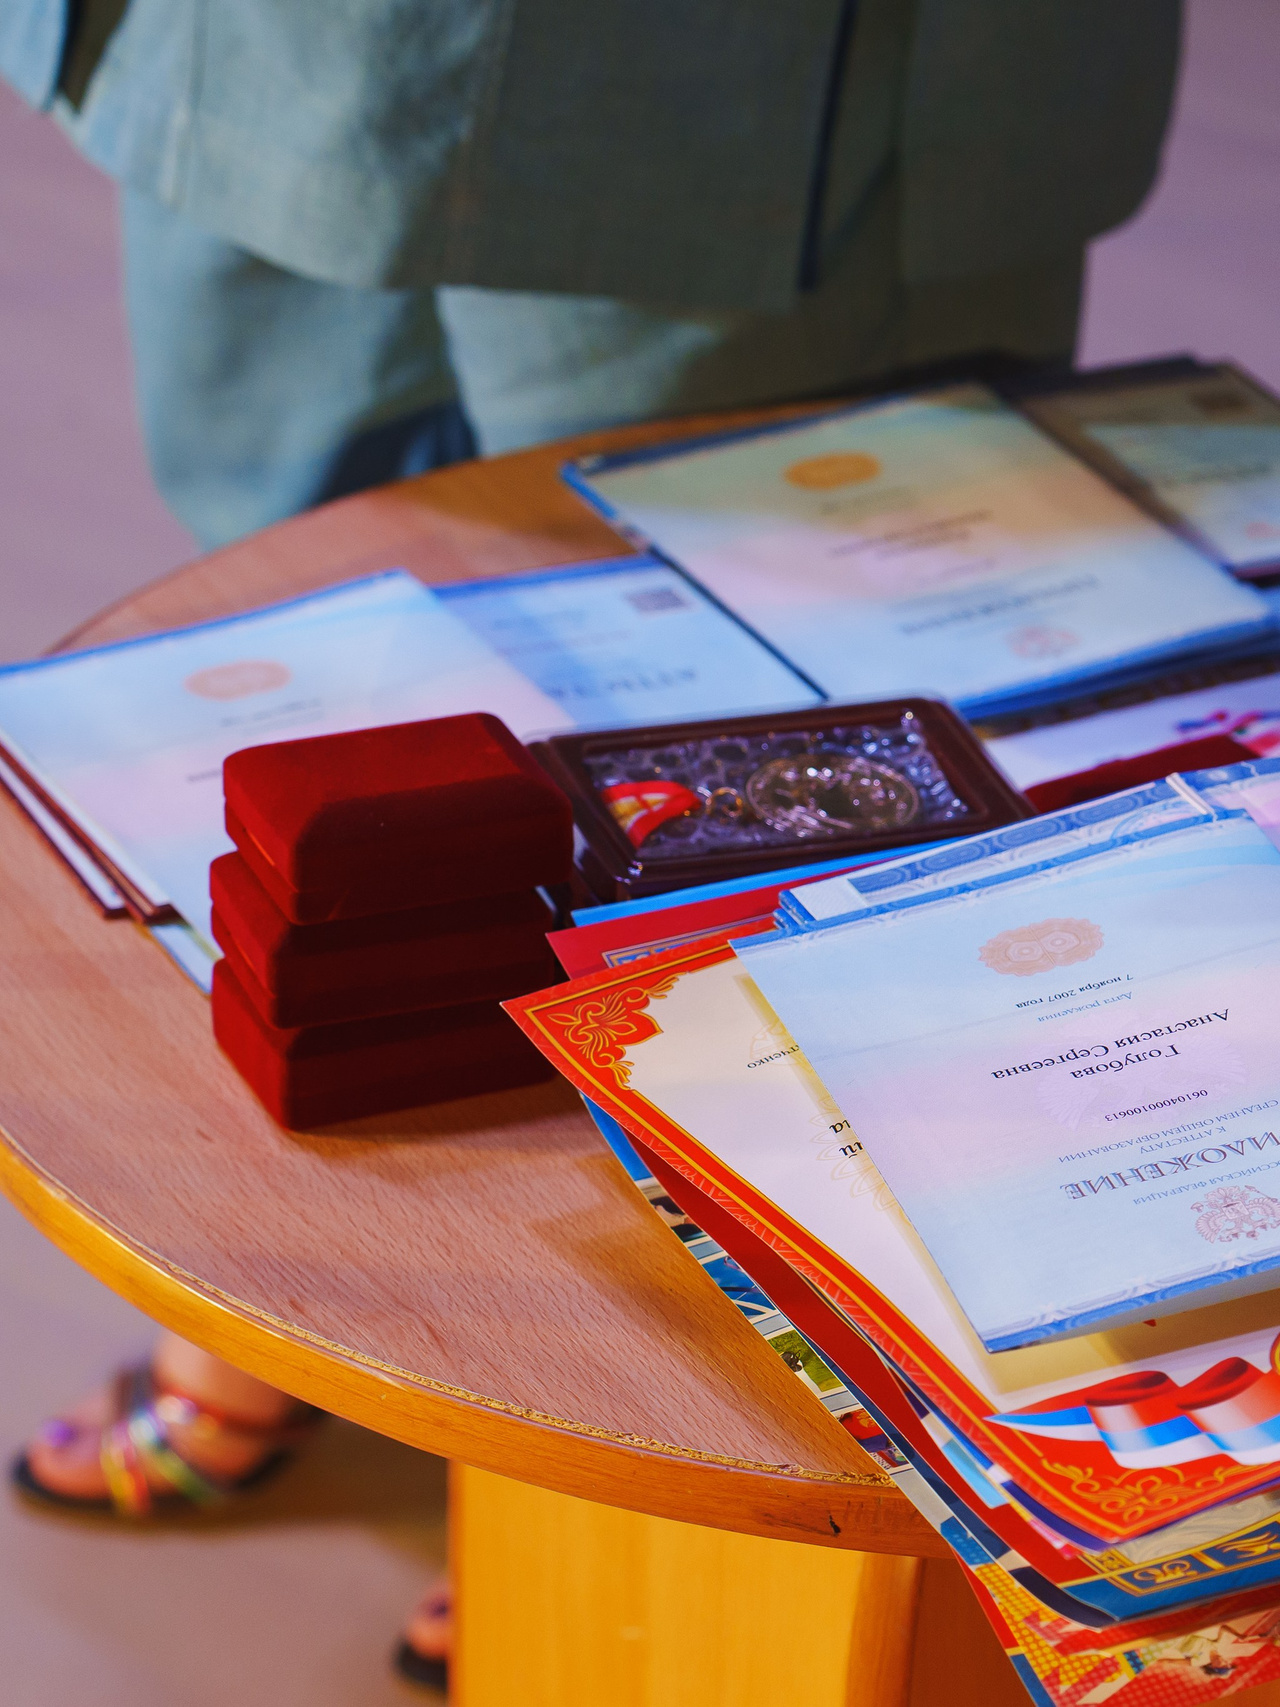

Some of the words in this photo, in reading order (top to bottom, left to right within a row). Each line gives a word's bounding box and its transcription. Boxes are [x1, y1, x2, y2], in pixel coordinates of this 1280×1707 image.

[1046, 988, 1077, 1003] 2007
[1078, 976, 1122, 994] ноября
[1015, 997, 1044, 1010] года
[1037, 998, 1102, 1023] рождения
[1103, 991, 1134, 1007] Дата
[1114, 1008, 1230, 1049] Анастасия
[990, 1043, 1110, 1080] Сергеевна
[1069, 1043, 1181, 1080] Голубова
[1104, 1088, 1209, 1122] 06104000100613
[1215, 1099, 1279, 1123] СРЕДНЕМ
[1161, 1117, 1214, 1138] ОБЩЕМ
[1215, 1125, 1226, 1134] К
[1058, 1131, 1161, 1164] ОБРАЗОВАНИИ
[1139, 1128, 1213, 1154] АТТЕСТАТУ
[1132, 1180, 1207, 1205] ФЕДЕРАЦИЯ
